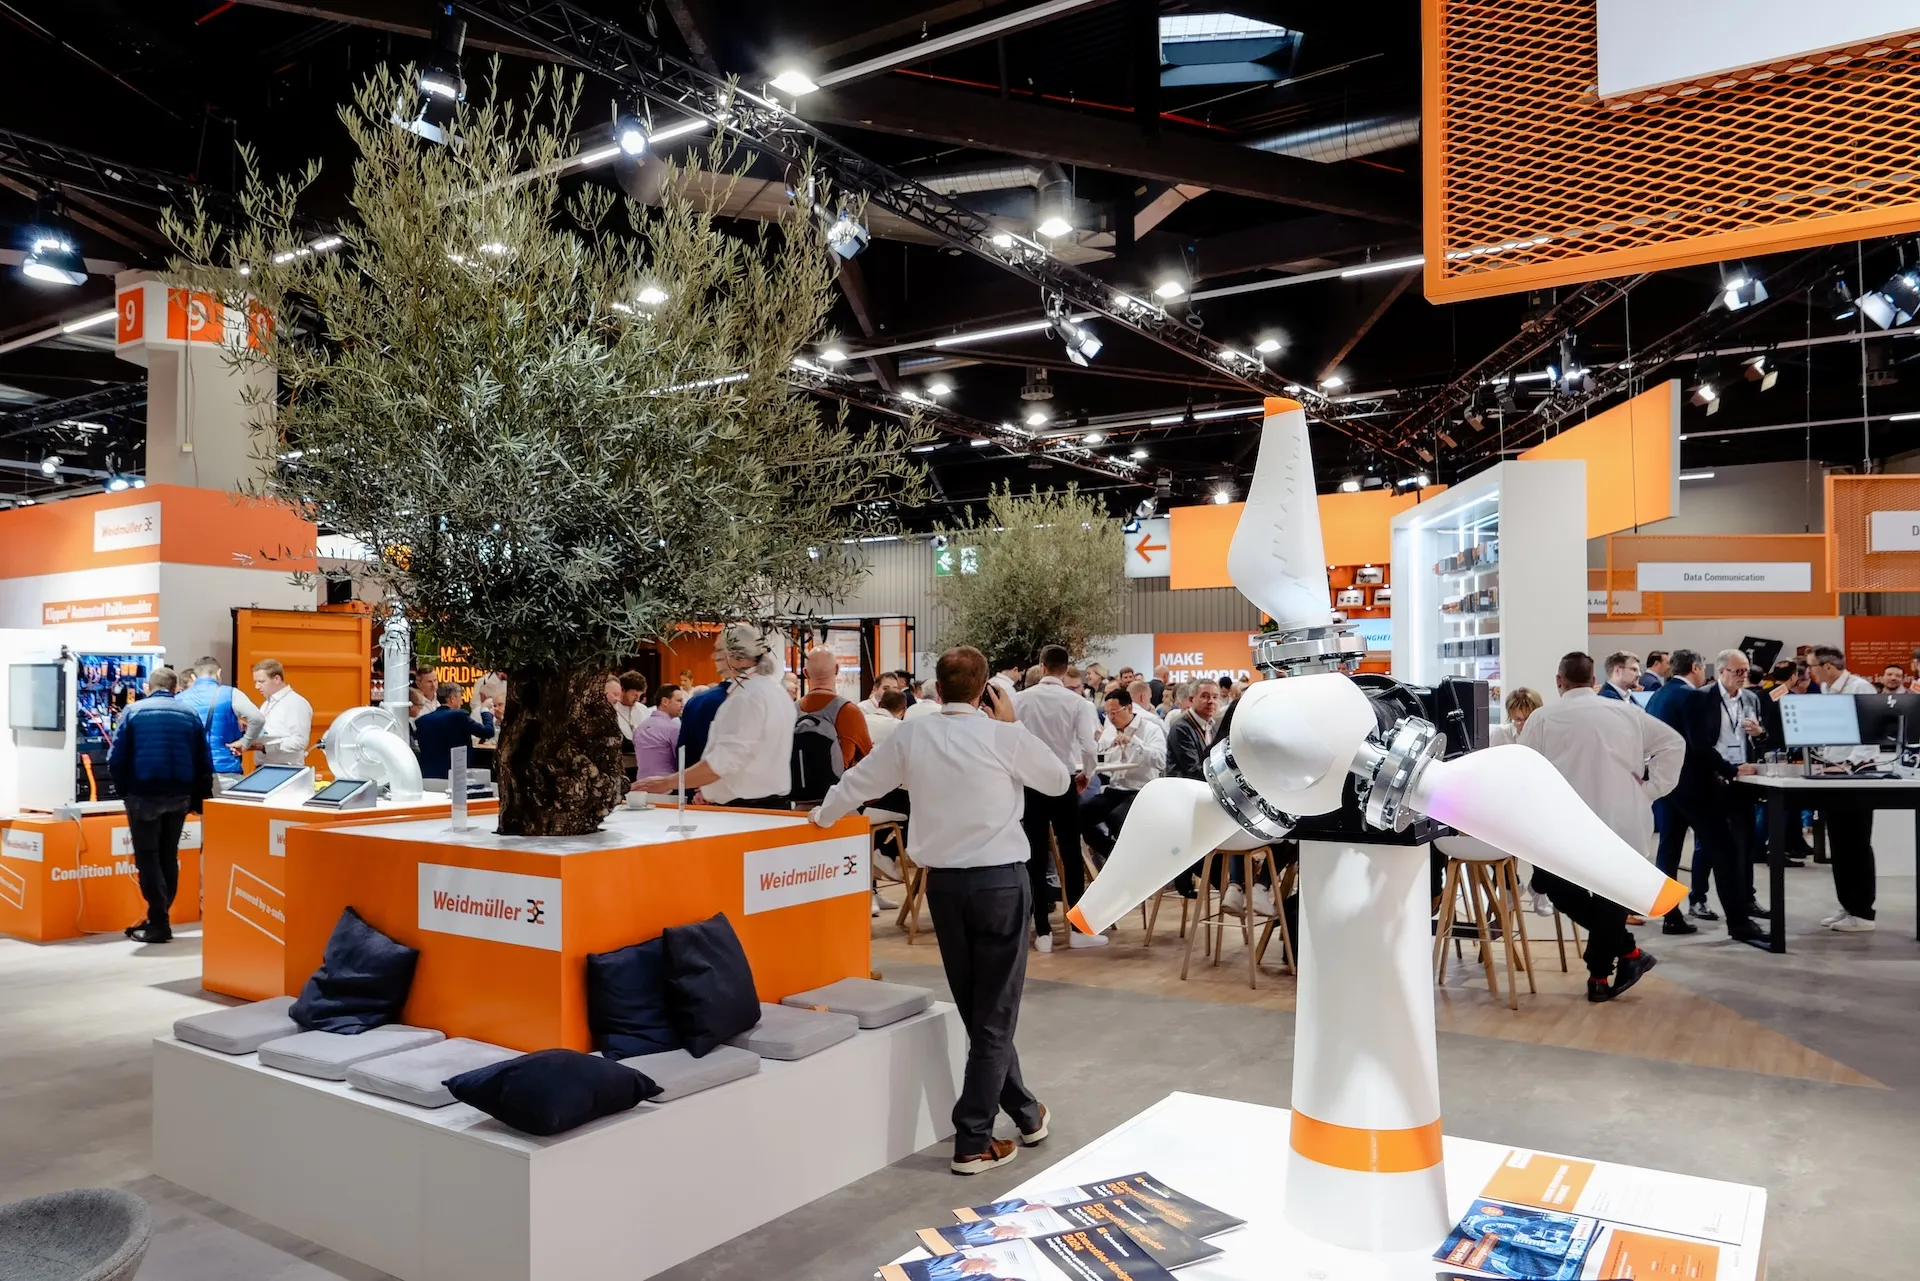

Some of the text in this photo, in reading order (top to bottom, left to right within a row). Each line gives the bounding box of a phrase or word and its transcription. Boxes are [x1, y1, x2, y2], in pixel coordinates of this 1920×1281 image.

[126, 300, 136, 332] 9
[186, 300, 207, 332] 9
[1684, 573, 1765, 582] Data Communication
[1160, 652, 1204, 666] MAKE
[435, 666, 470, 683] WORLD
[1167, 669, 1251, 684] HE WORLD
[52, 864, 112, 882] Condition
[760, 863, 841, 892] Weidmüller
[433, 890, 522, 922] Weidmüller
[1062, 1234, 1084, 1252] 2024
[1075, 1231, 1109, 1263] Executive
[1128, 1227, 1166, 1250] Navigator
